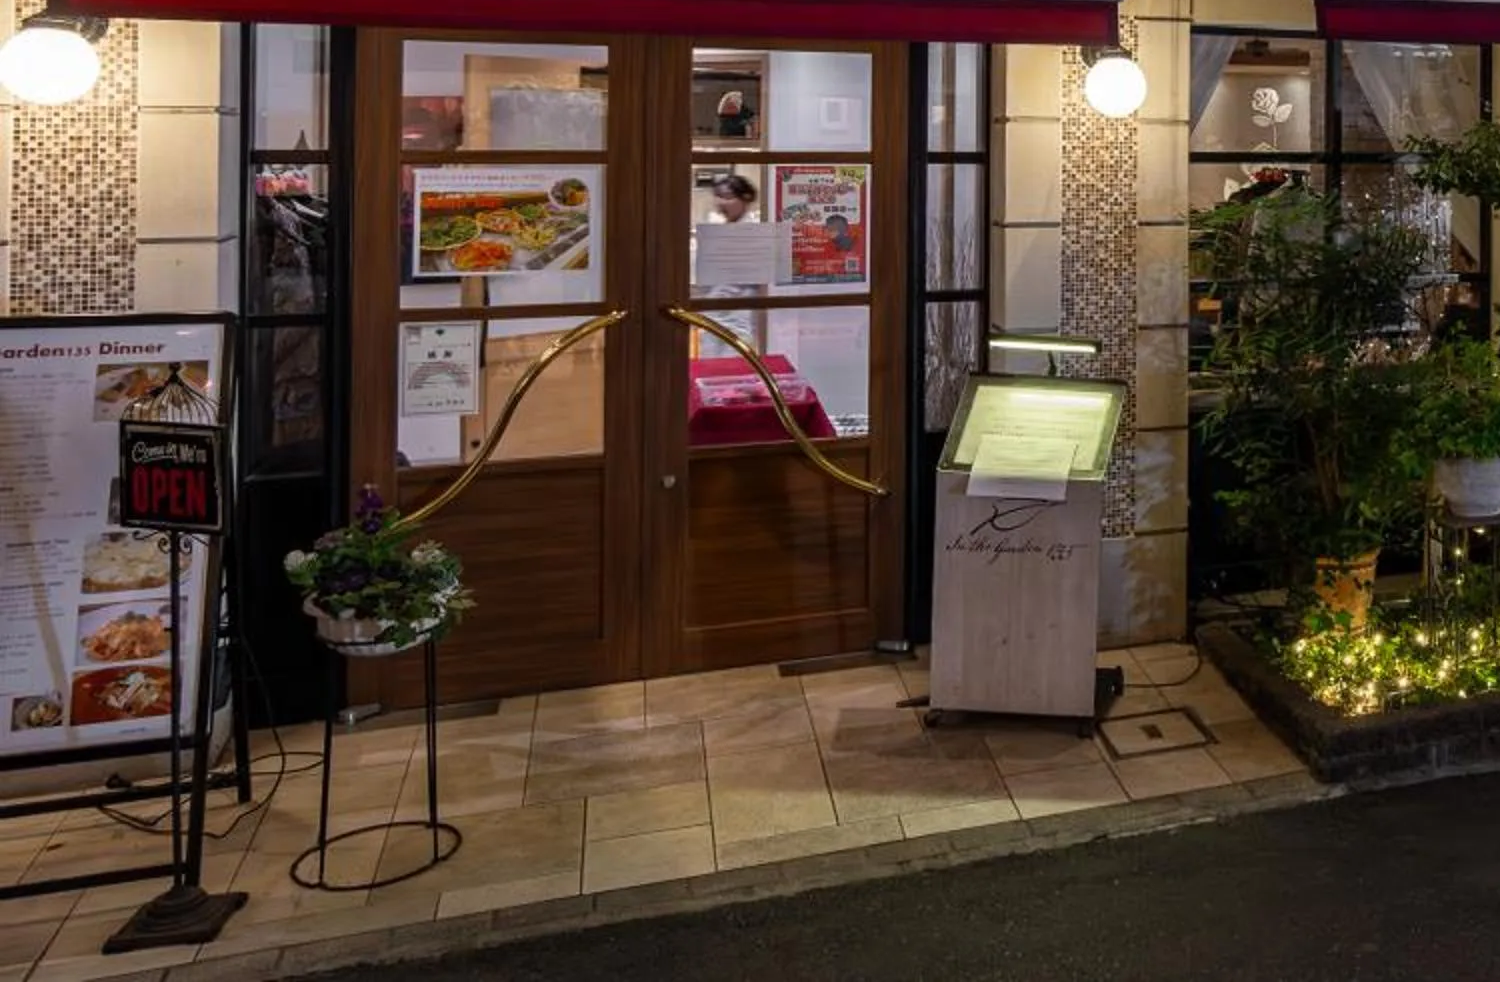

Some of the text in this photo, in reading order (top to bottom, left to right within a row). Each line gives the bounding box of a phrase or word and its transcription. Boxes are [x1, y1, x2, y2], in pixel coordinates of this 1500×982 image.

[0, 341, 167, 359] arden135 Dinner
[132, 465, 206, 518] OPEN
